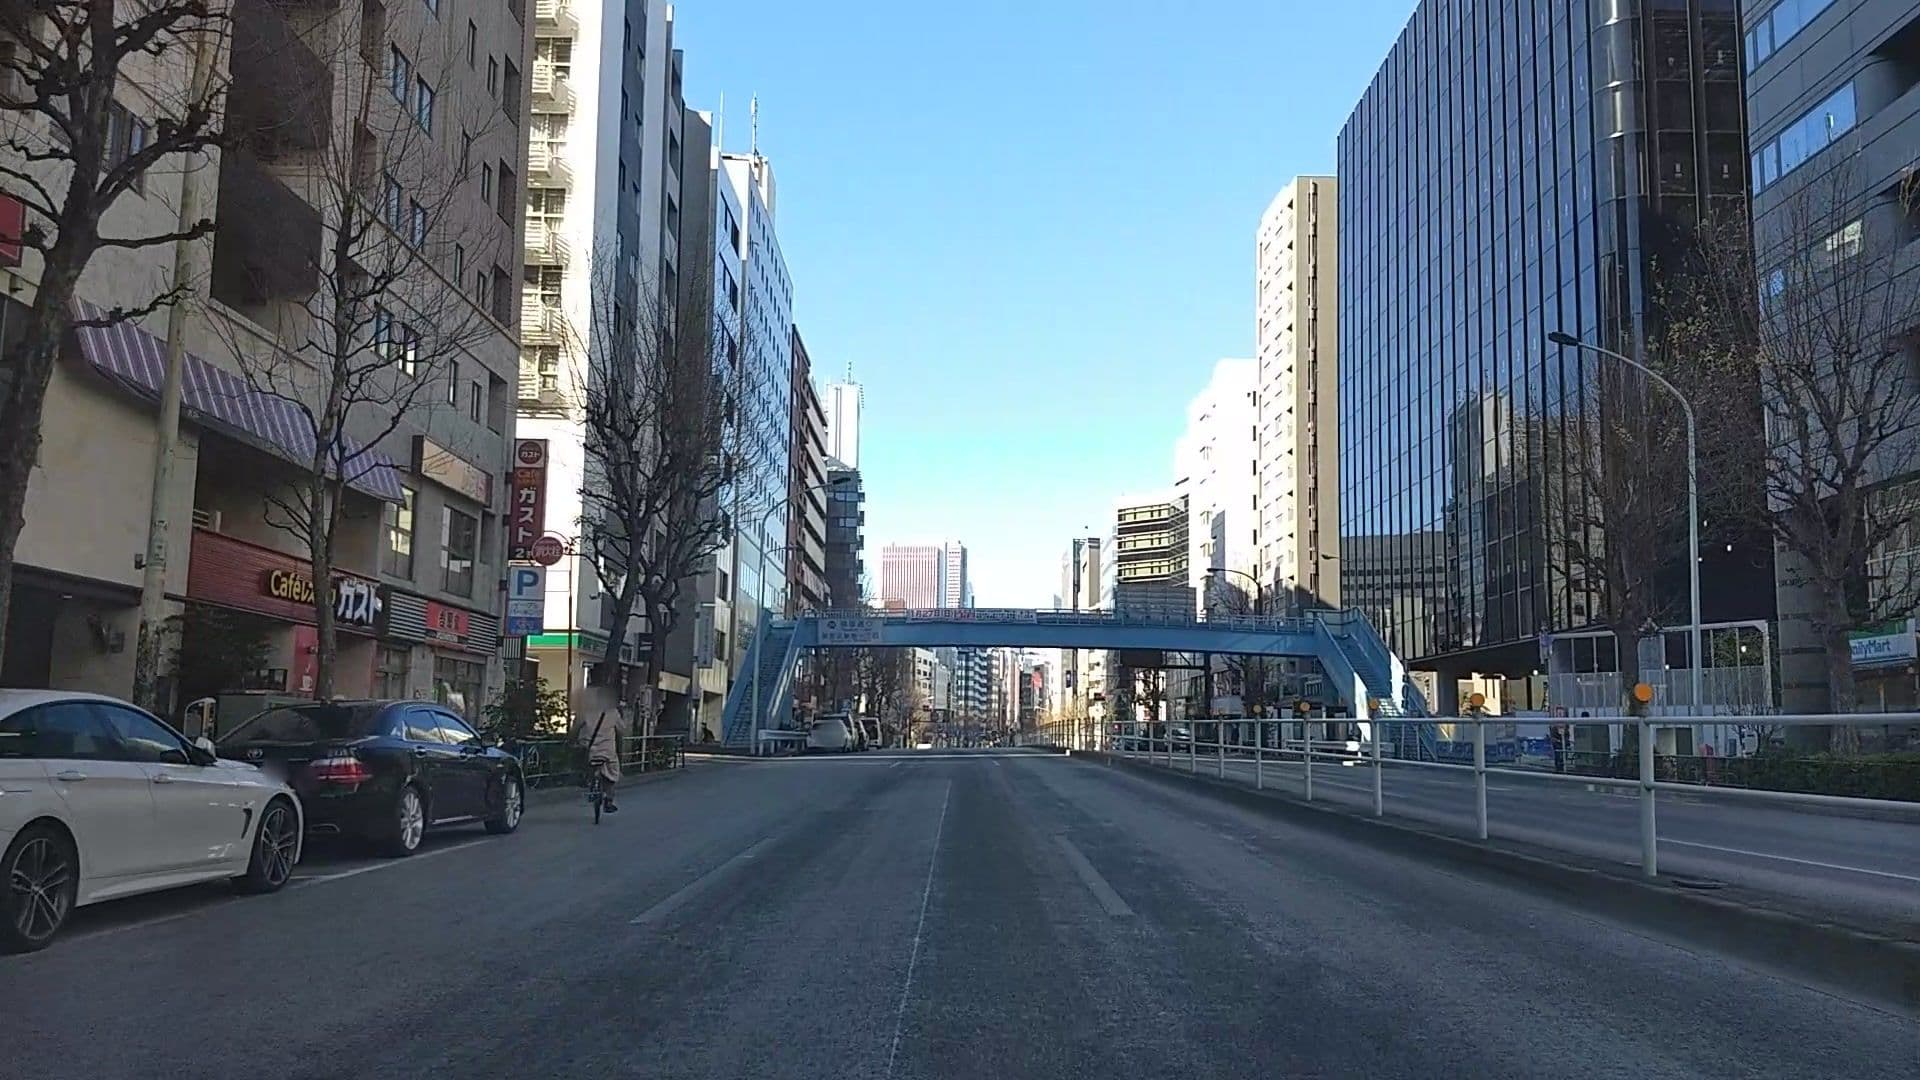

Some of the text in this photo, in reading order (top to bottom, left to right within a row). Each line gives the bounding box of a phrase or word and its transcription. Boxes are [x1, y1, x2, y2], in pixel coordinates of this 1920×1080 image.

[519, 486, 536, 543] ガスト
[337, 577, 382, 624] ガスト
[517, 570, 539, 595] P
